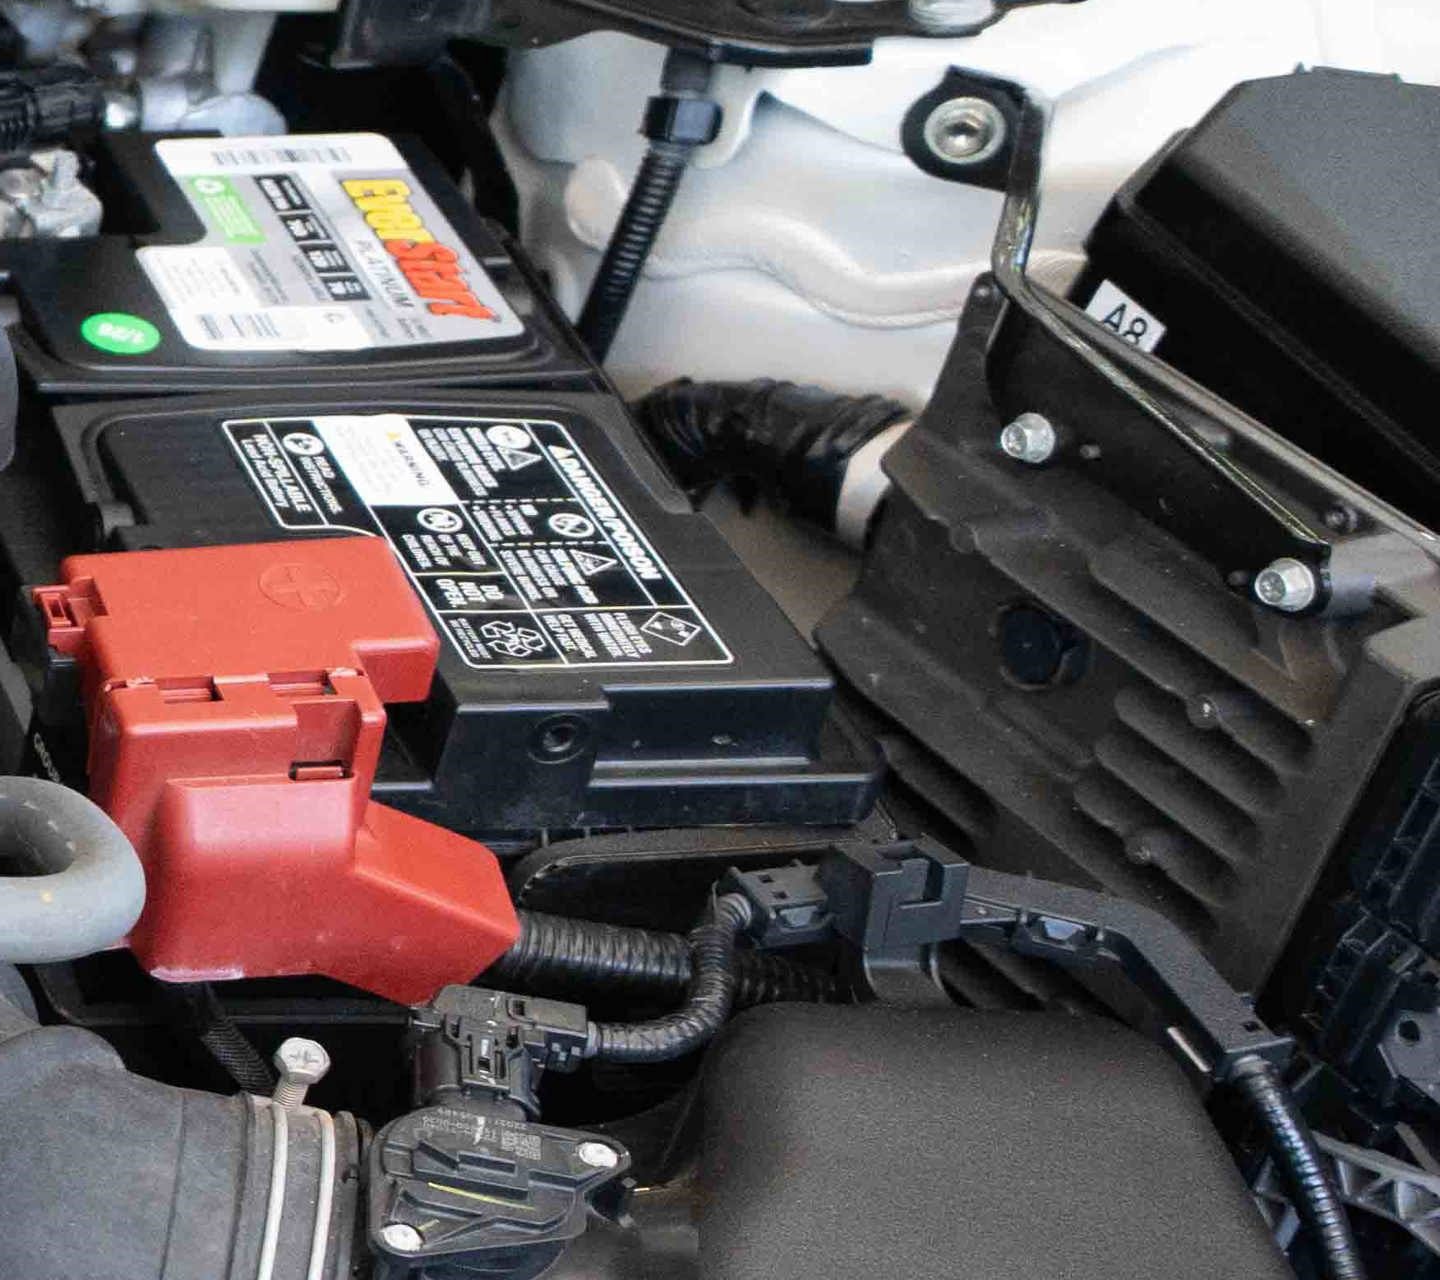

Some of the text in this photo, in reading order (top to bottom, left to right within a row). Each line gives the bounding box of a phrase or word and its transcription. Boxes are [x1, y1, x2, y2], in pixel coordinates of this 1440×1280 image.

[341, 179, 495, 319] EverStart
[352, 238, 415, 308] PLATINUM
[1100, 303, 1150, 346] A8
[250, 434, 314, 511] NON-SPILLABLE
[556, 458, 662, 579] DANGER/POISON
[455, 581, 487, 602] NOT
[477, 585, 507, 599] DO
